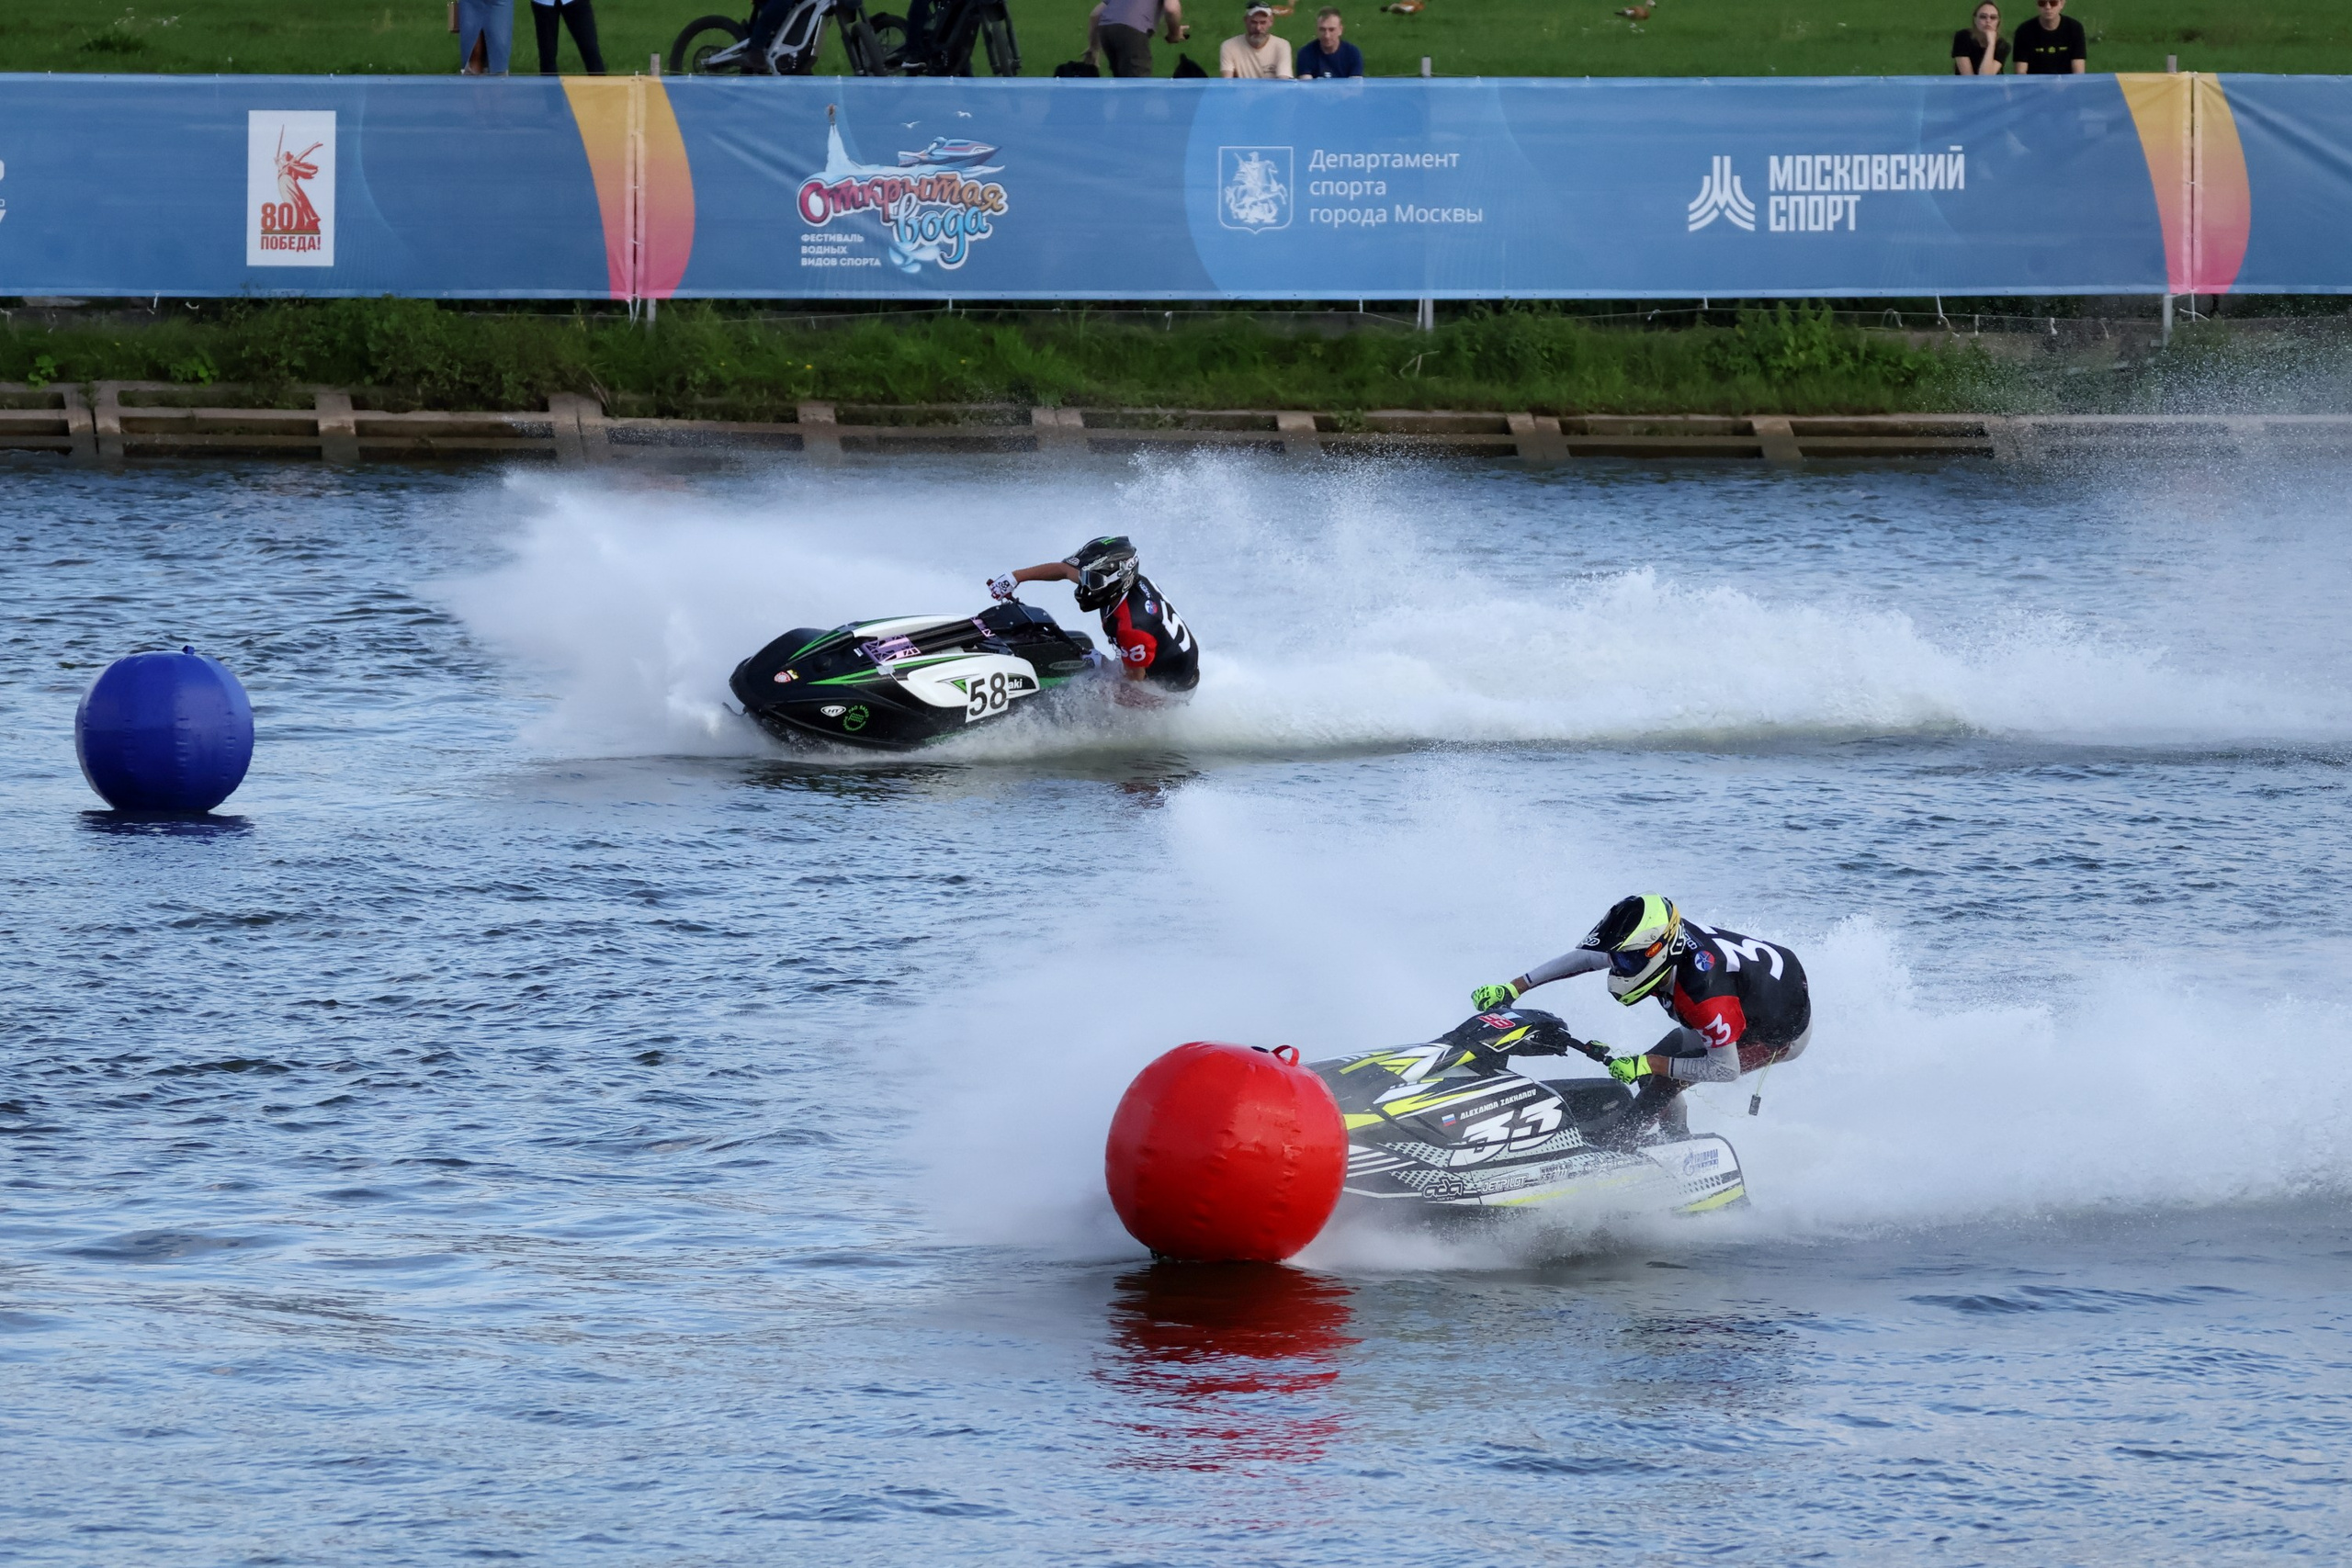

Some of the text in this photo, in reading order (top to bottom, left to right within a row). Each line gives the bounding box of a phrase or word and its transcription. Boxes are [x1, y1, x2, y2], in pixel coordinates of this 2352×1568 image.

[1308, 149, 1460, 173] Департамент
[1770, 145, 1965, 191] МОСКОВСКИЙ
[798, 172, 1007, 224] Открытая
[1309, 180, 1387, 200] спорта
[261, 202, 294, 230] 80
[1309, 204, 1483, 228] города Москвы
[1770, 195, 1860, 231] СПОРТ
[800, 233, 864, 243] ФЕСТИВАЛЬ
[894, 193, 990, 265] вода
[261, 236, 321, 253] ПОБЕДА!
[800, 245, 848, 254] ВОДНЫХ
[800, 257, 881, 266] ВИДОВ СПОРТА
[969, 672, 1007, 716] 58
[1449, 1096, 1562, 1166] 33
